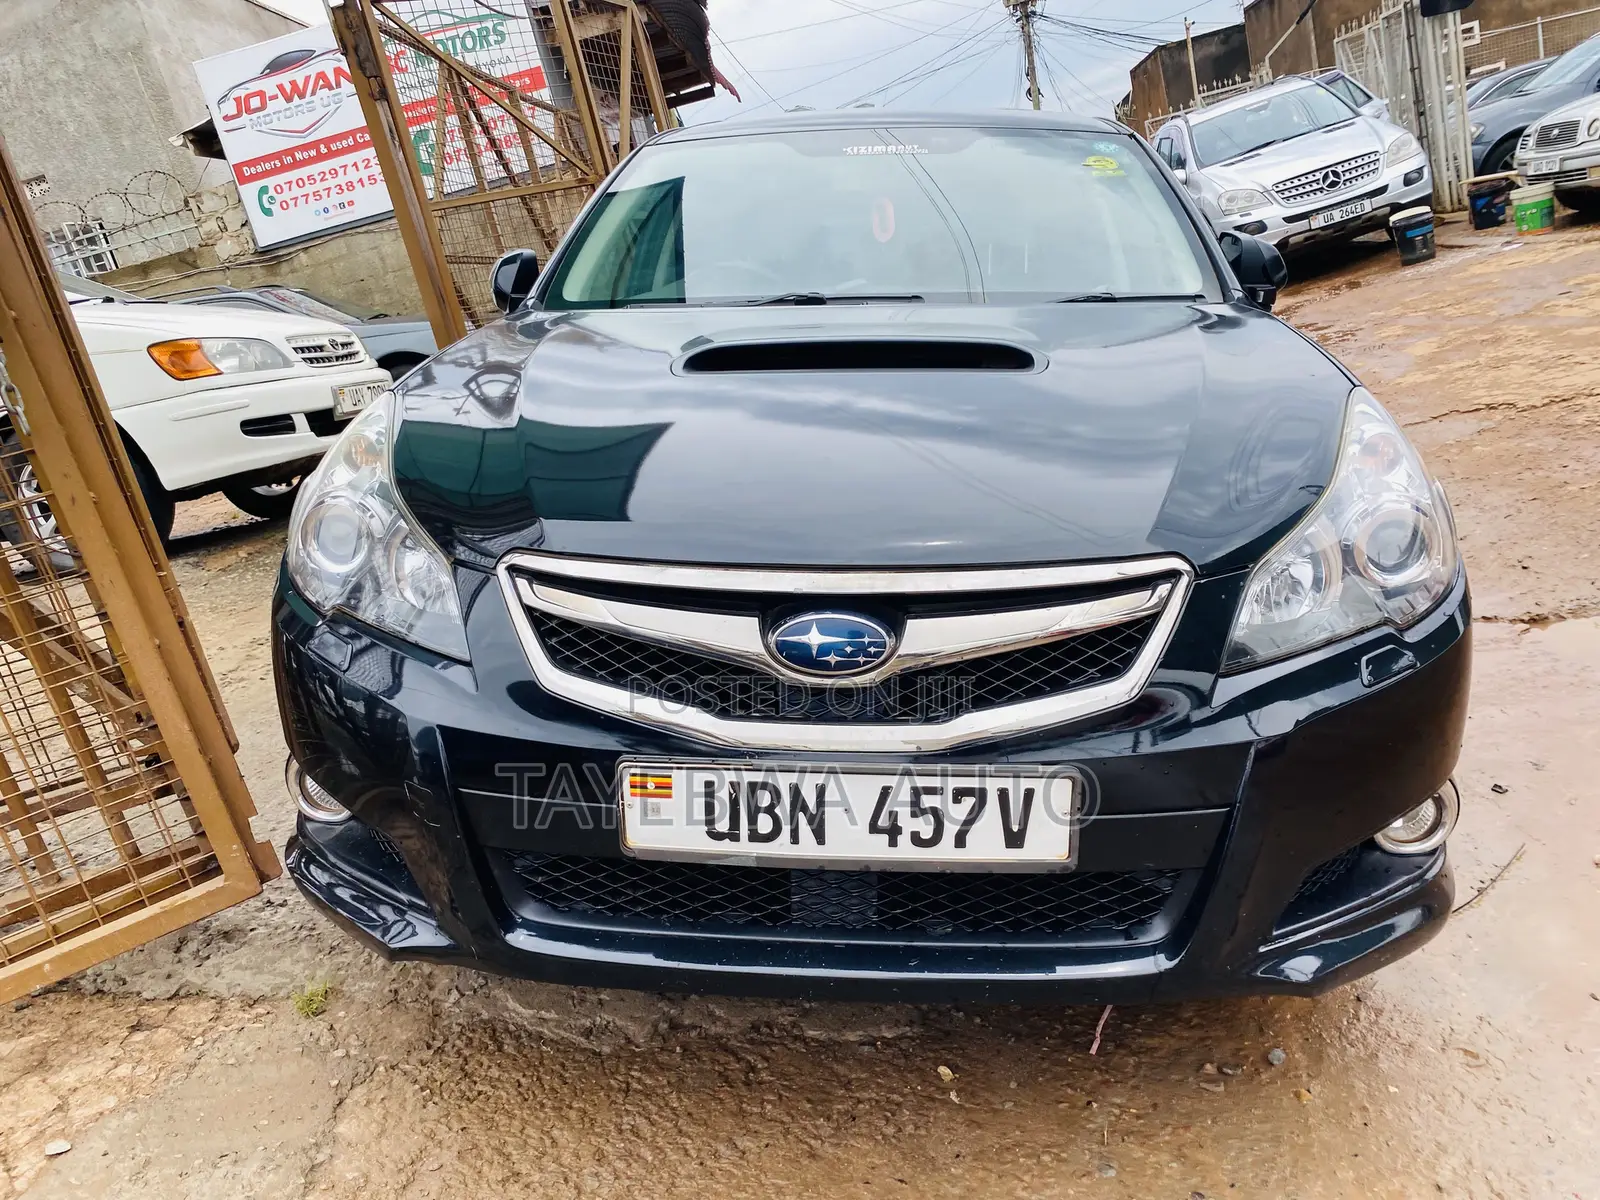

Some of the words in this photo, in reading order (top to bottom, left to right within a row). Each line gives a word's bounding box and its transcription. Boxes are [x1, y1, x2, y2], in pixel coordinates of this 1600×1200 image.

[249, 100, 317, 130] MOTORS
[320, 91, 344, 108] UG
[242, 159, 282, 177] Dealers
[283, 154, 294, 166] in
[295, 146, 318, 162] New
[319, 143, 329, 155] &
[329, 135, 355, 151] used
[1322, 212, 1335, 224] UA
[703, 780, 827, 846] UBN
[868, 785, 1034, 849] 457V
